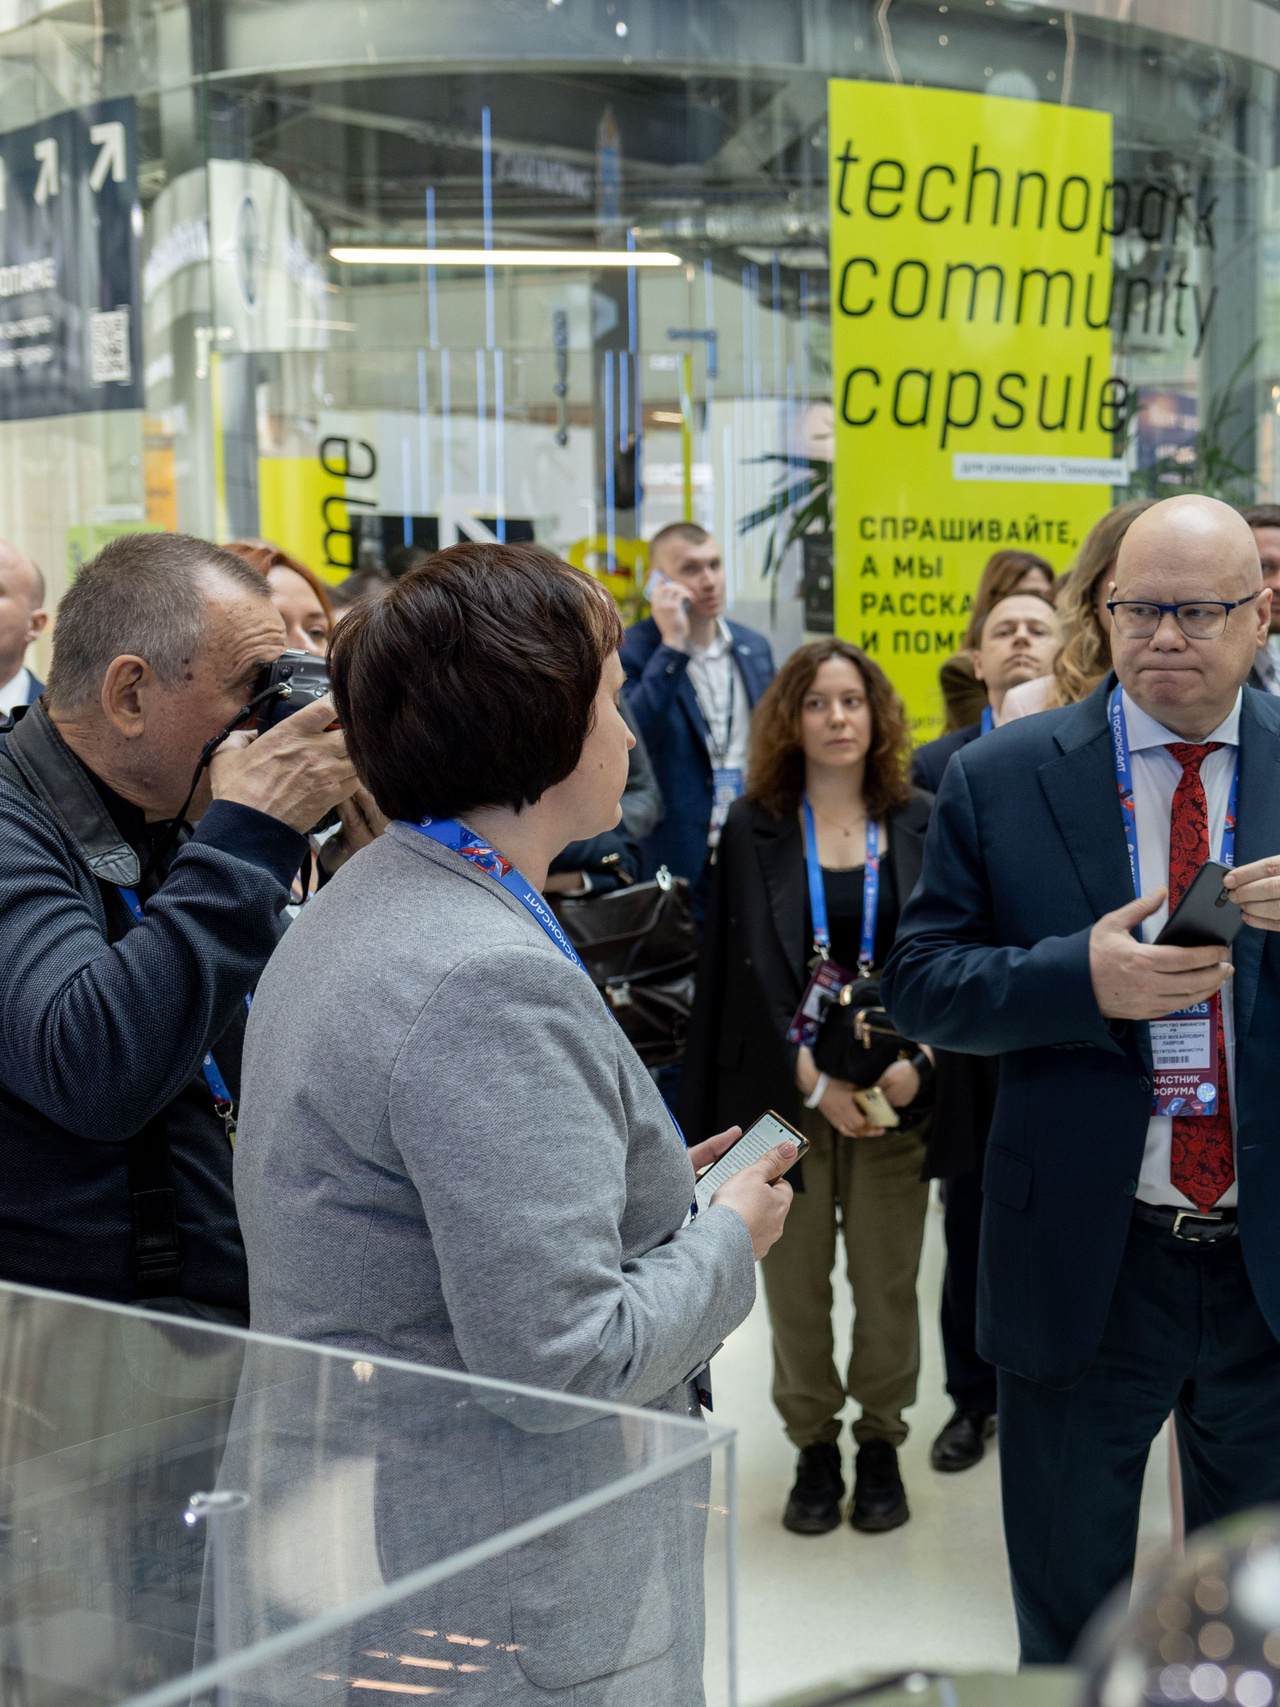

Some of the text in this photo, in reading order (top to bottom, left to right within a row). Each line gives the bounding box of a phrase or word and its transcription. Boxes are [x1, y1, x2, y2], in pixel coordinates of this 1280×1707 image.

[835, 139, 1218, 257] technopark
[837, 256, 1219, 358] community
[839, 355, 1131, 450] capsule
[859, 514, 1079, 548] СПРАШИВАЙТЕ,
[861, 555, 943, 579] А МЫ
[860, 592, 973, 616] РАССКА
[861, 630, 965, 654] И ПОМ
[1113, 715, 1126, 773] ГОСКОНСАЛТ
[523, 892, 581, 967] ОСКОНСАЛТ
[1153, 1075, 1200, 1085] ЧАСТНИК
